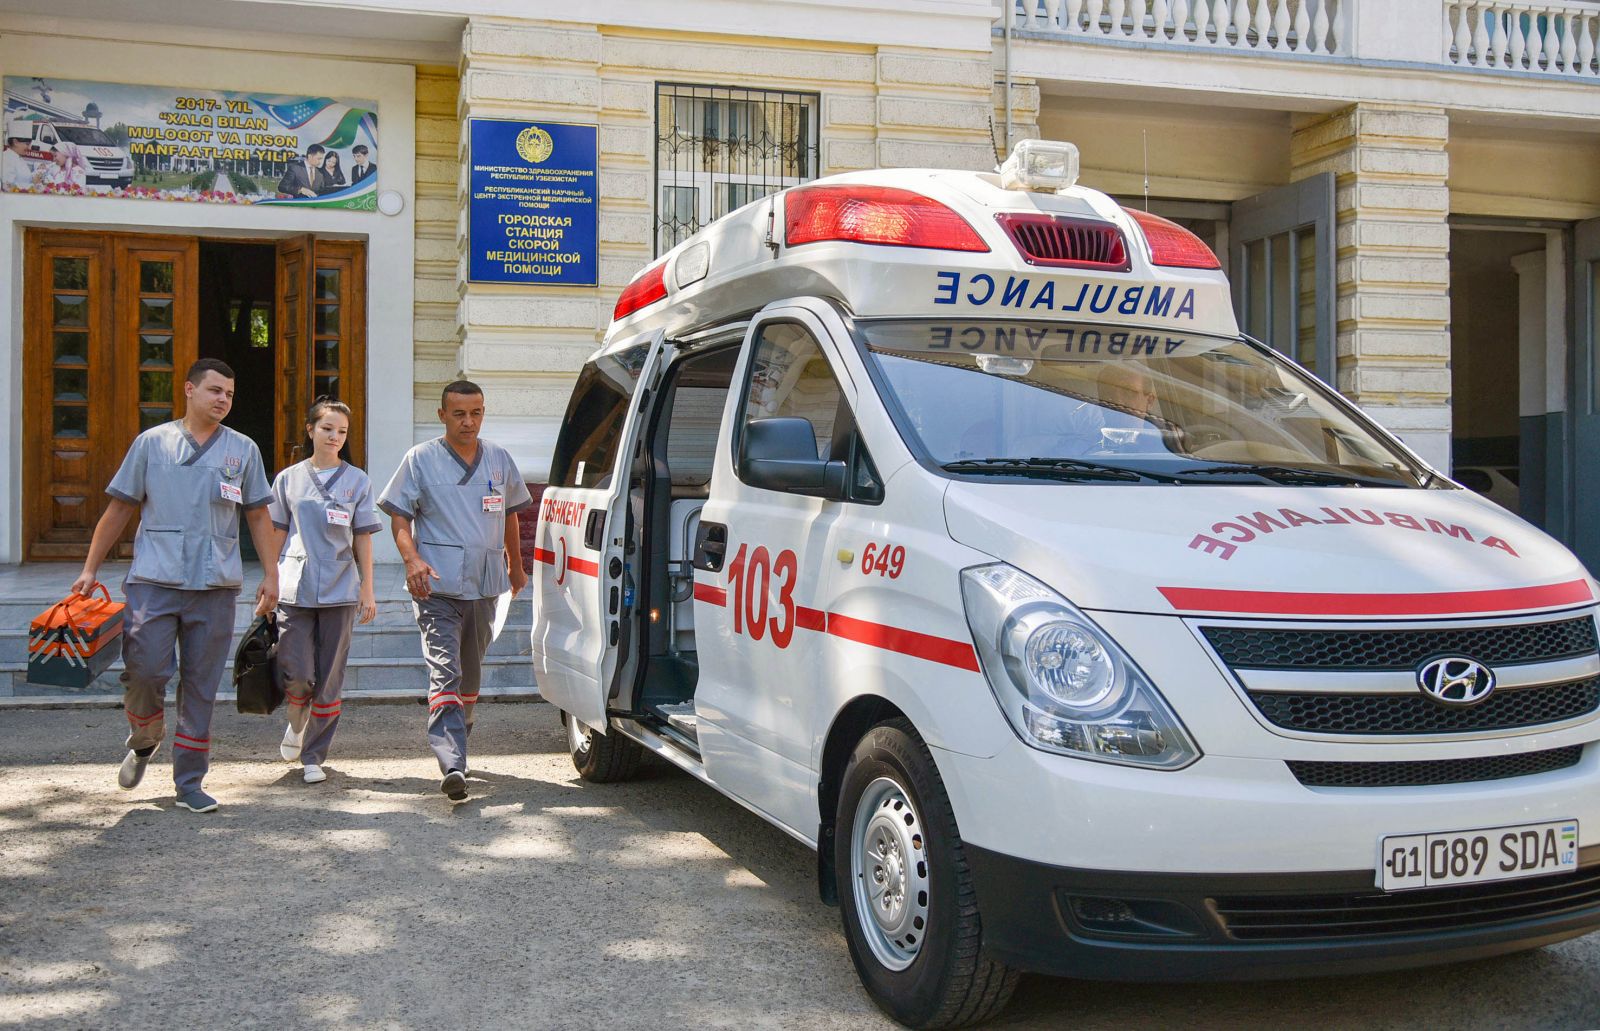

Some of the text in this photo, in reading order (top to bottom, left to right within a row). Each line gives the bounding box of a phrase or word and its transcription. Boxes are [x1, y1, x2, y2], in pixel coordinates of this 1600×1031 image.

[225, 100, 253, 114] YIL
[217, 115, 268, 131] BILAN
[127, 126, 298, 148] MULOQOT VA INSON
[130, 143, 250, 160] MANFAATLARI
[474, 165, 594, 177] МИНИСТЕРСТВО ЗДРАВООХРАНЕНИЯ
[490, 173, 578, 183] РЕСПУБЛИКИ УЗБЕКИСТАН
[484, 186, 584, 197] РЕСПУБЛИКАНСКИЙ НАУЧНЫЙ
[497, 194, 541, 202] ЭКСТРЕННОЙ
[542, 196, 592, 204] МЕДИЦИНСКОЙ
[519, 202, 550, 210] ПОМОЩИ
[498, 214, 572, 227] ГОРОДСКАЯ
[505, 227, 563, 239] СТАНЦИЯ
[508, 239, 559, 250] СКОРОЙ
[486, 251, 581, 264] МЕДИЦИНСКОЙ
[504, 263, 562, 276] ПОМОЩИ
[541, 498, 586, 528] TOSHKENT
[861, 542, 906, 580] 649
[728, 543, 798, 649] 103
[1392, 828, 1559, 879] 01 089 SDA
[1561, 850, 1575, 865] UZ
